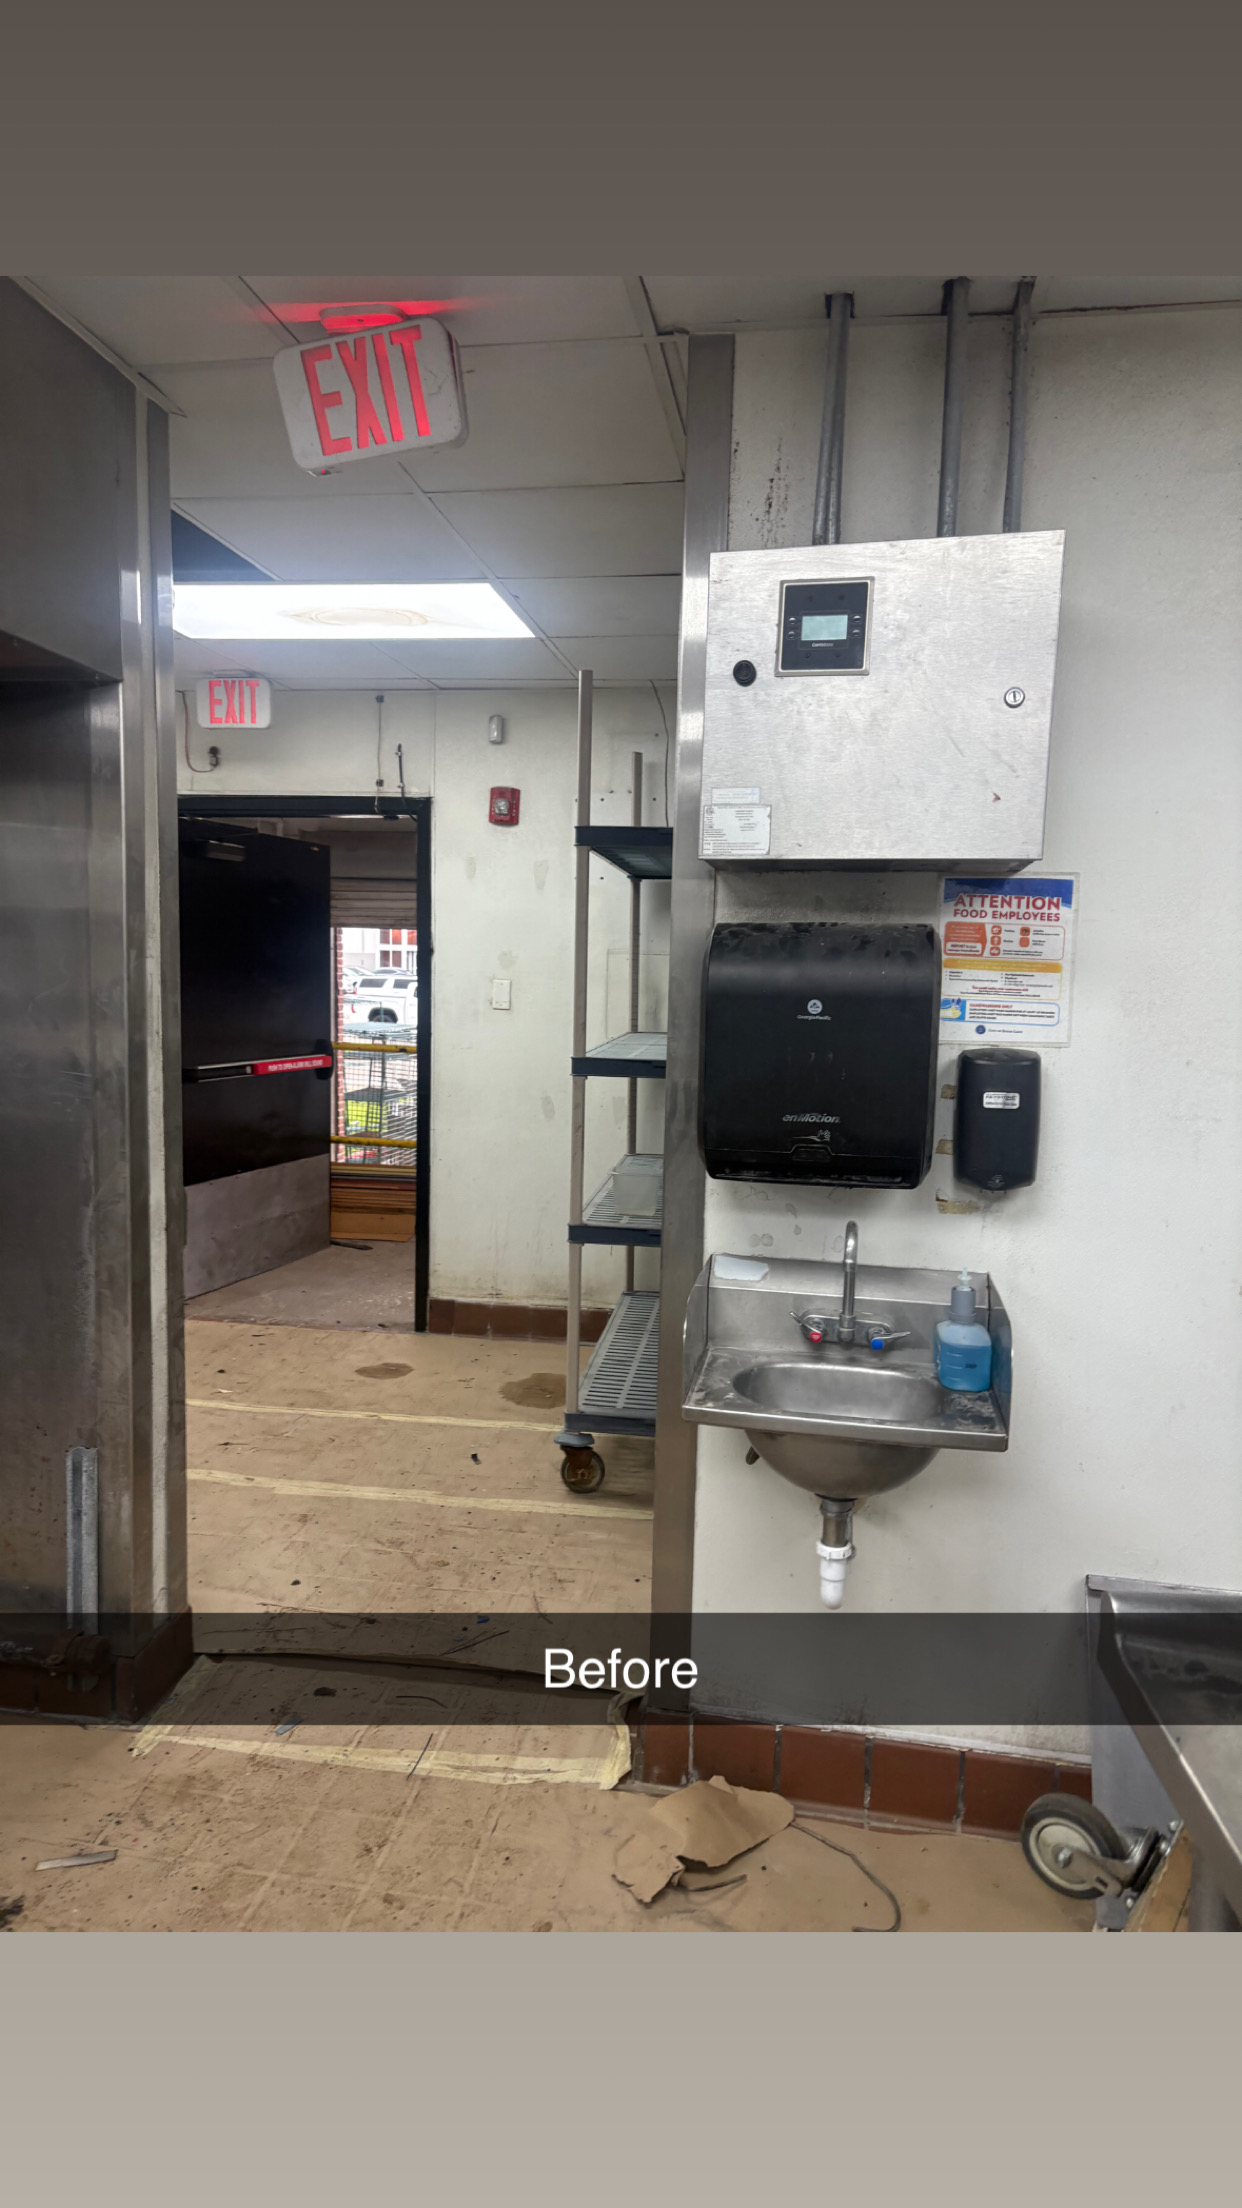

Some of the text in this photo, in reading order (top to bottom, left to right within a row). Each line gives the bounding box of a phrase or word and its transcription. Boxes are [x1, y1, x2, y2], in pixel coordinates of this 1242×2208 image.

[300, 324, 432, 456] EXIT
[208, 680, 260, 724] EXIT
[953, 893, 1061, 911] ATTENTION
[953, 909, 1061, 922] FOOD EMPLOYEES
[782, 1112, 841, 1123] enMotion
